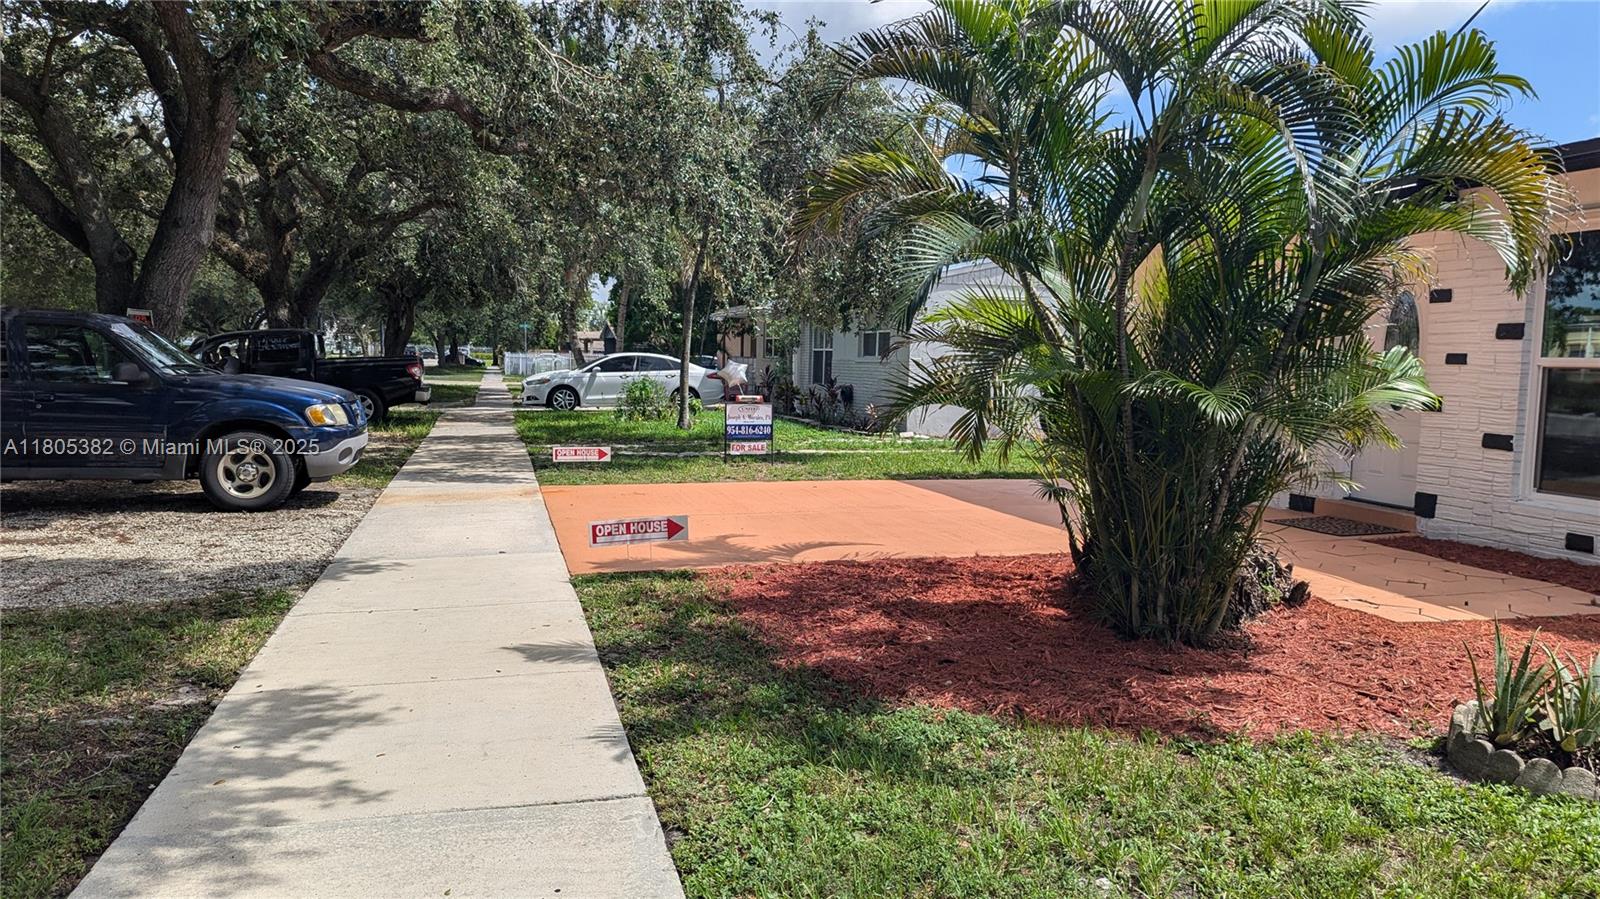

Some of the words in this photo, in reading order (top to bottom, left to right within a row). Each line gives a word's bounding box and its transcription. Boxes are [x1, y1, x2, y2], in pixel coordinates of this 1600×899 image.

[577, 448, 599, 456] HOUSE
[595, 524, 626, 536] OPEN
[630, 521, 668, 533] HOUSE
